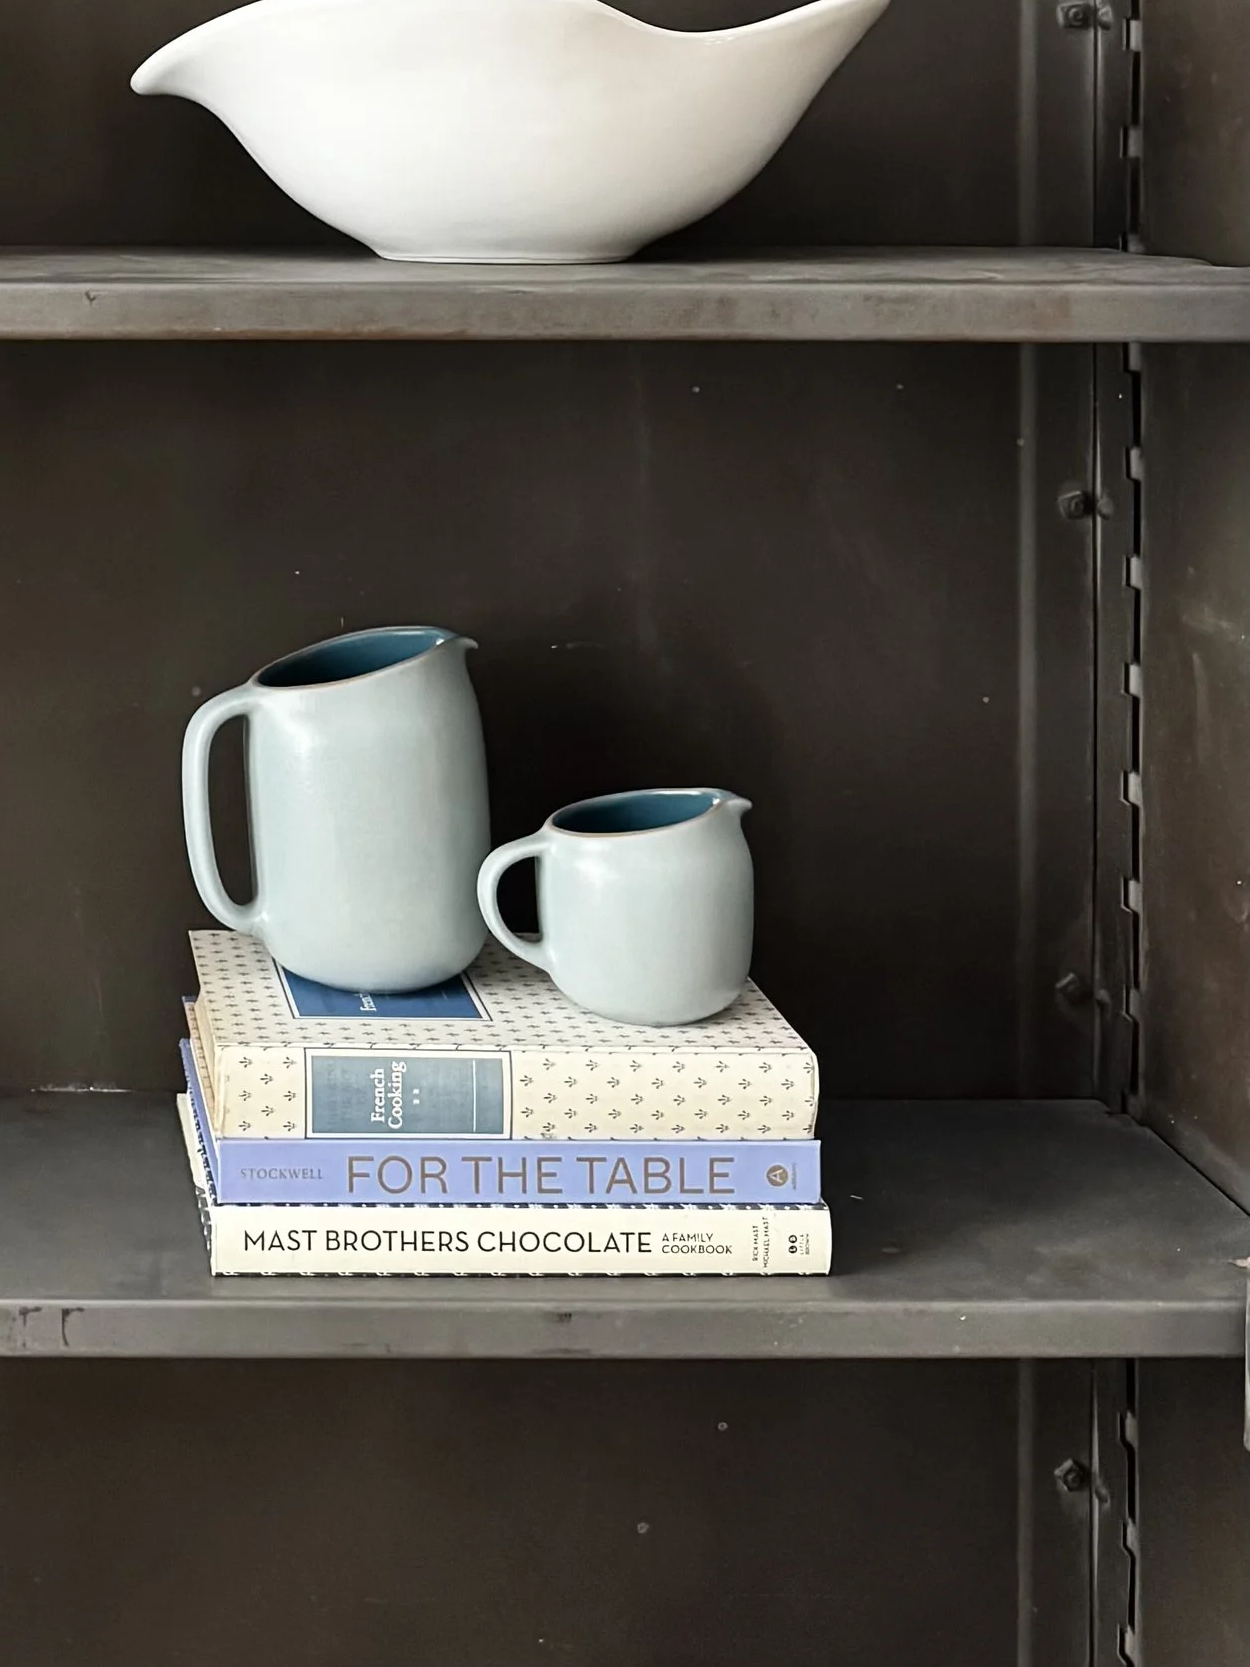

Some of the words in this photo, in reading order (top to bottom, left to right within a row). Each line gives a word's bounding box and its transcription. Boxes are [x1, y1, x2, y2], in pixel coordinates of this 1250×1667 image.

[370, 1068, 385, 1123] French
[387, 1061, 407, 1129] Cooking
[240, 1167, 324, 1181] STOCKWELL
[347, 1156, 449, 1195] FOR
[461, 1156, 563, 1194] THE
[575, 1156, 736, 1195] TABLE
[243, 1229, 319, 1252] MAST
[325, 1230, 469, 1253] BROTHERS
[477, 1230, 653, 1254] CHOCOLATE
[661, 1232, 670, 1242] A
[672, 1232, 714, 1243] FAMILY
[661, 1244, 733, 1254] COOKBOOK
